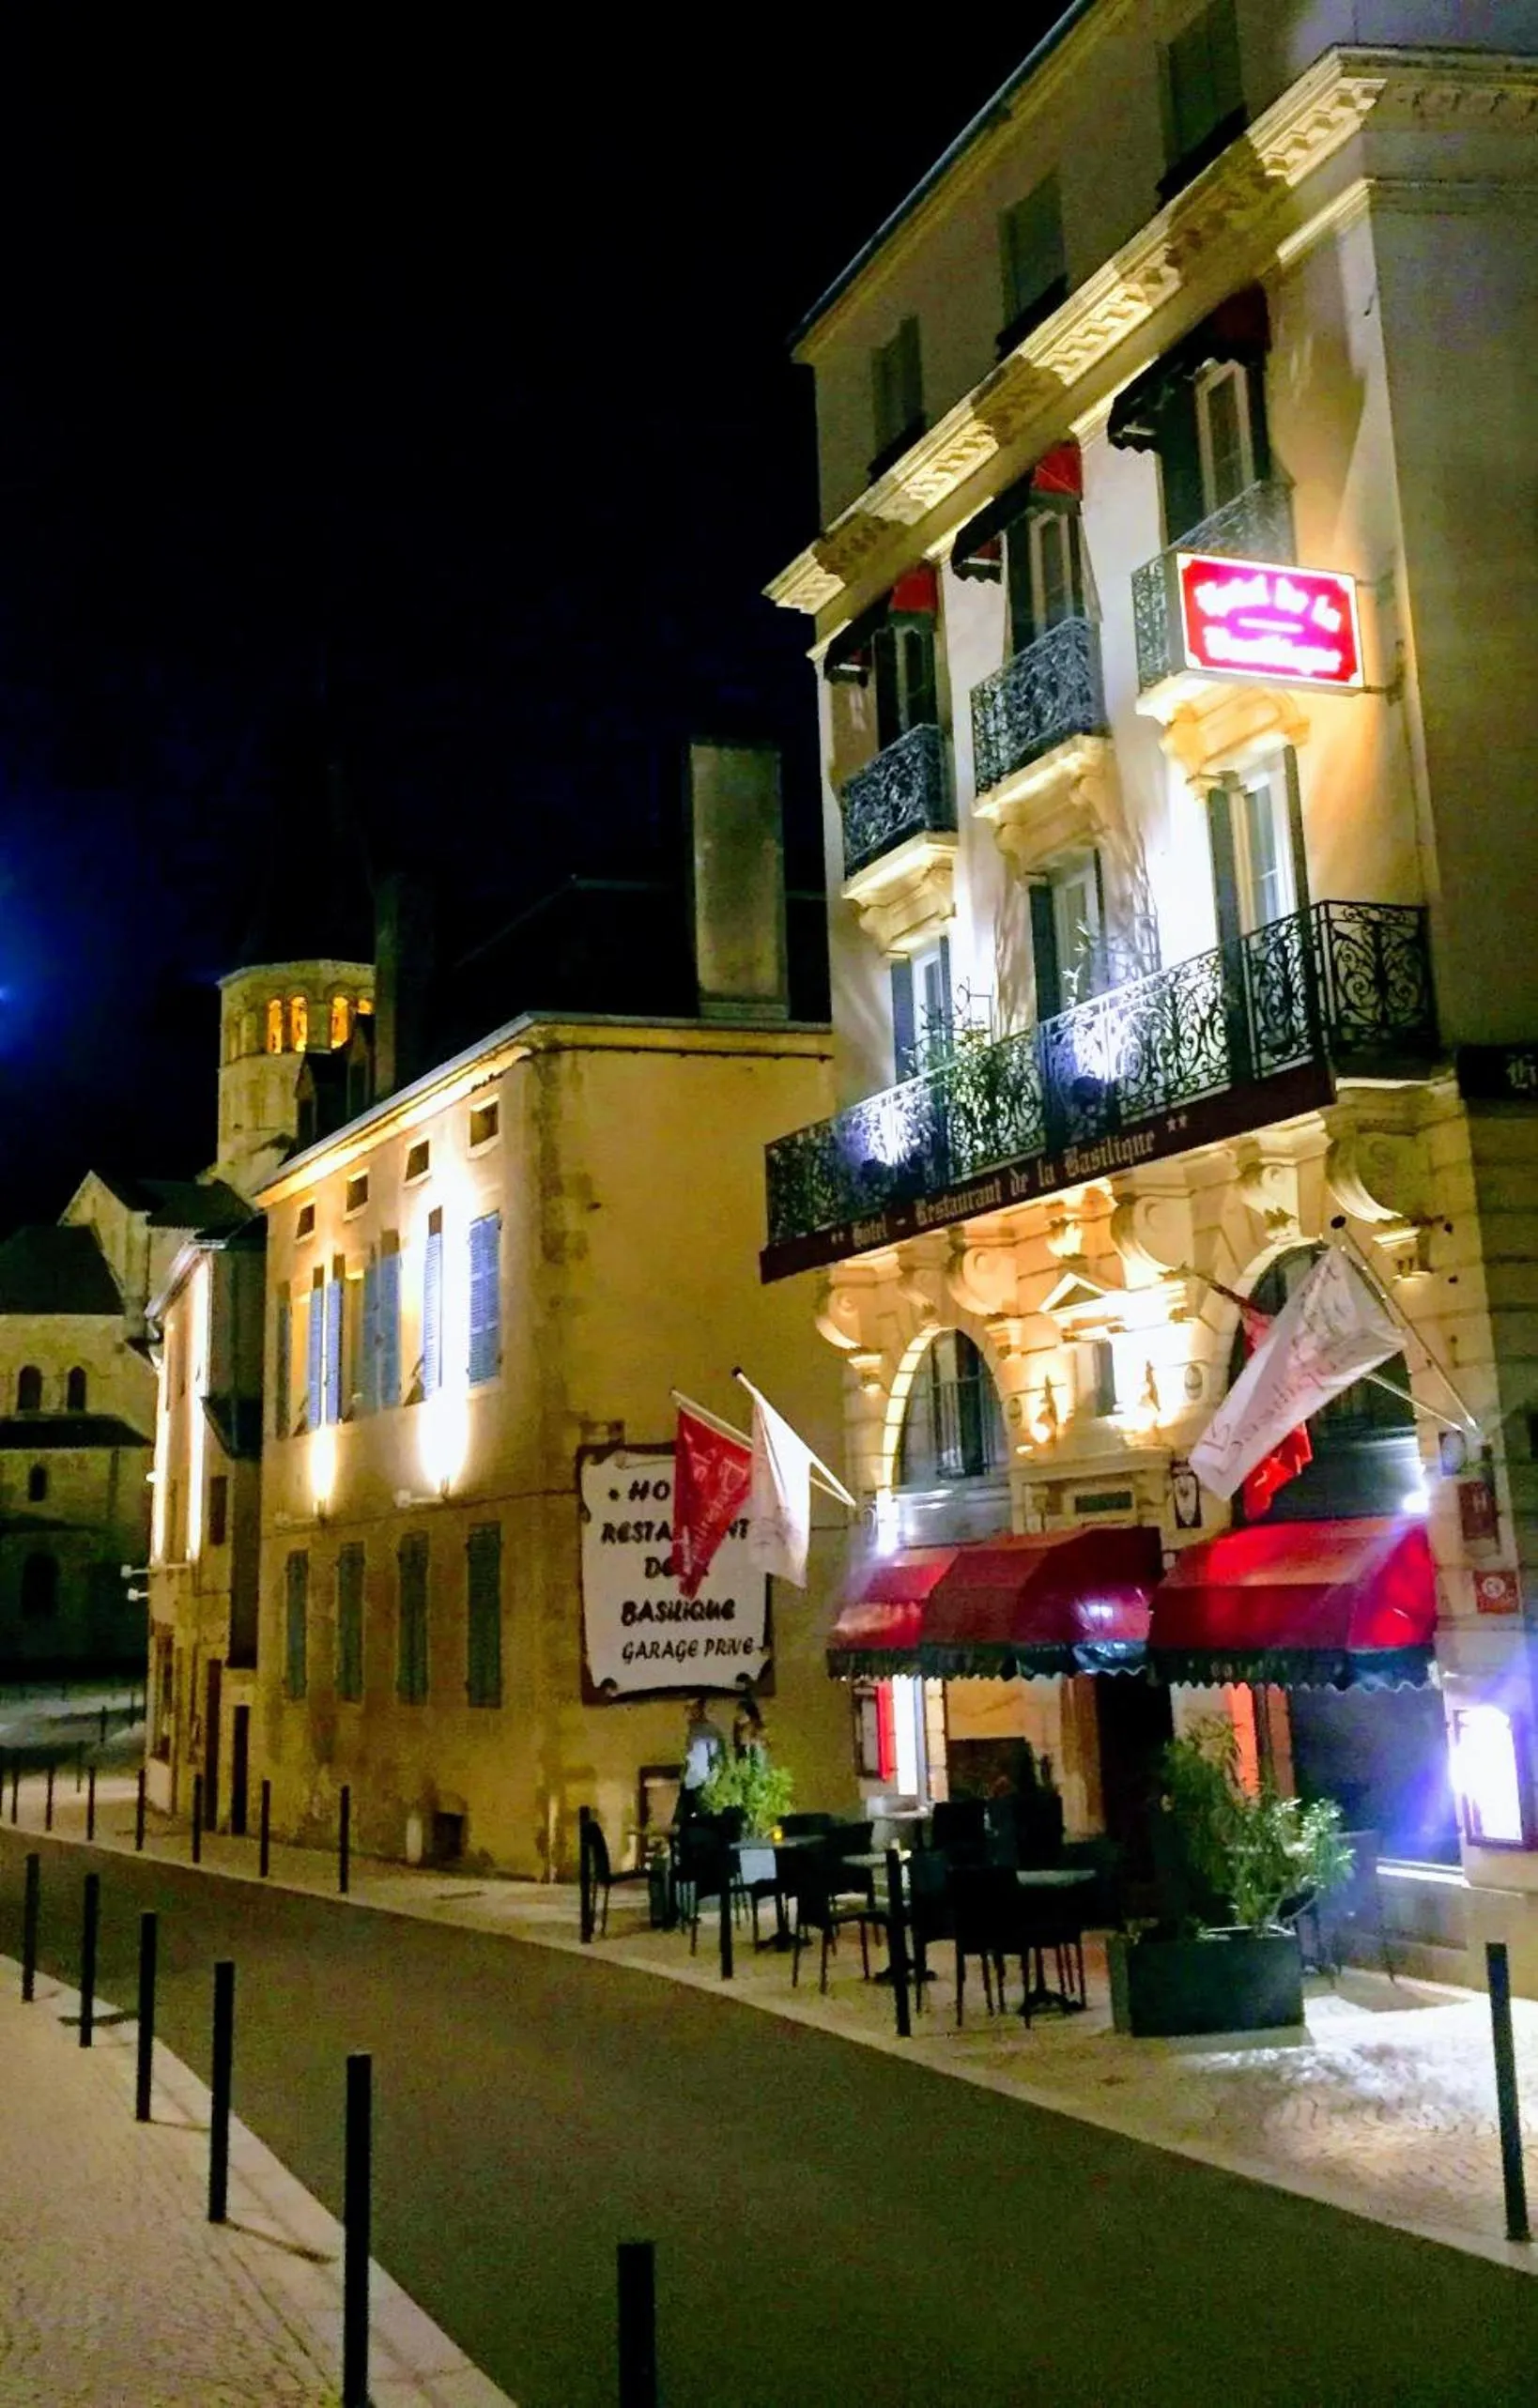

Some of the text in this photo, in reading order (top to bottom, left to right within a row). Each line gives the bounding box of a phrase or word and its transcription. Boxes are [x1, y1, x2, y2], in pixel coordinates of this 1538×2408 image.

[913, 1176, 1002, 1227] Restaurant
[1009, 1167, 1029, 1197] de
[1037, 1158, 1055, 1188] la
[1063, 1129, 1155, 1177] Basilique
[621, 1598, 735, 1626] BASILIQUE
[622, 1640, 699, 1664] GARAGE
